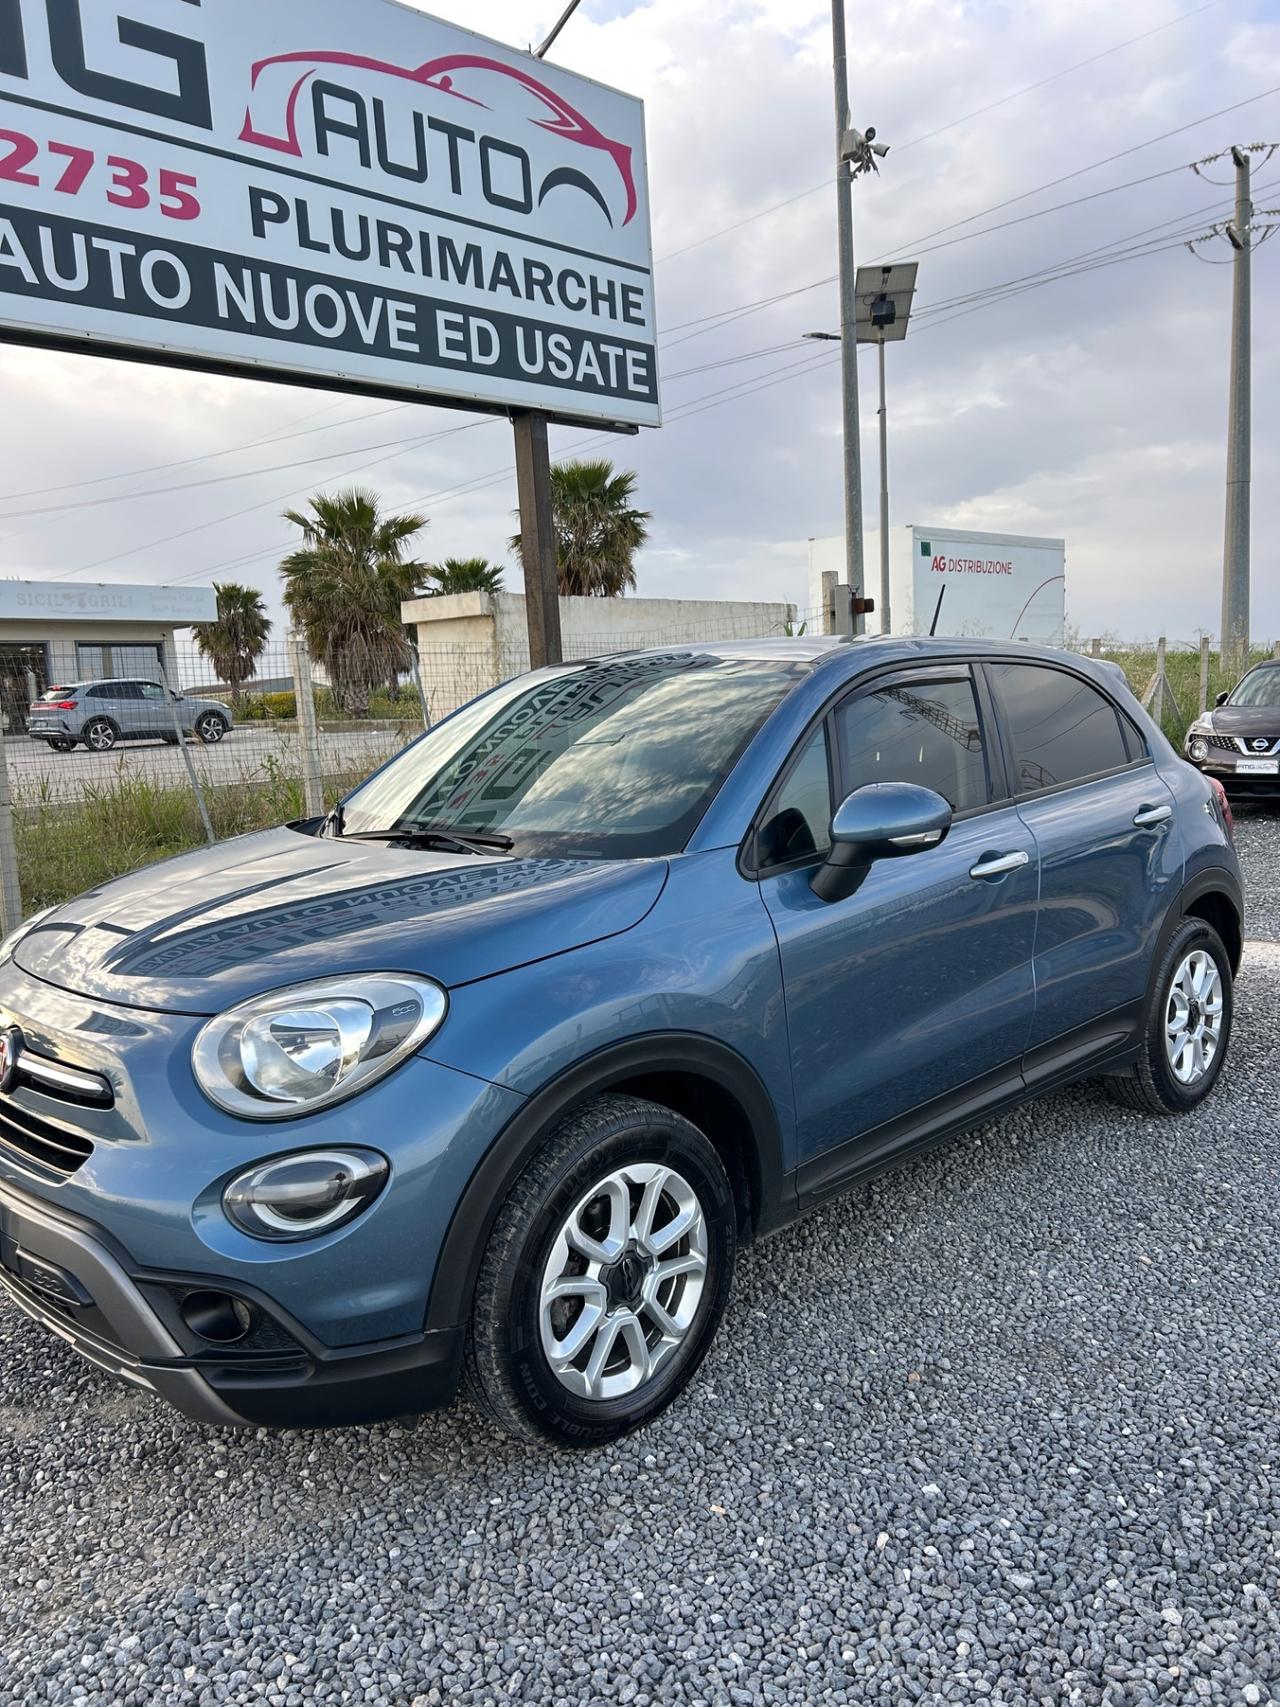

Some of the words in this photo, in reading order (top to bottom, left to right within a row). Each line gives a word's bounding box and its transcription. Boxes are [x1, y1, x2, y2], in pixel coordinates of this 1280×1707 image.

[311, 79, 533, 214] AUTO
[248, 185, 646, 327] PLURIMARCHE
[215, 261, 420, 353] NUOVE
[436, 311, 501, 366] ED
[516, 325, 650, 395] USATE
[931, 555, 946, 572] AG
[948, 558, 1012, 575] DISTRIBUZIONE
